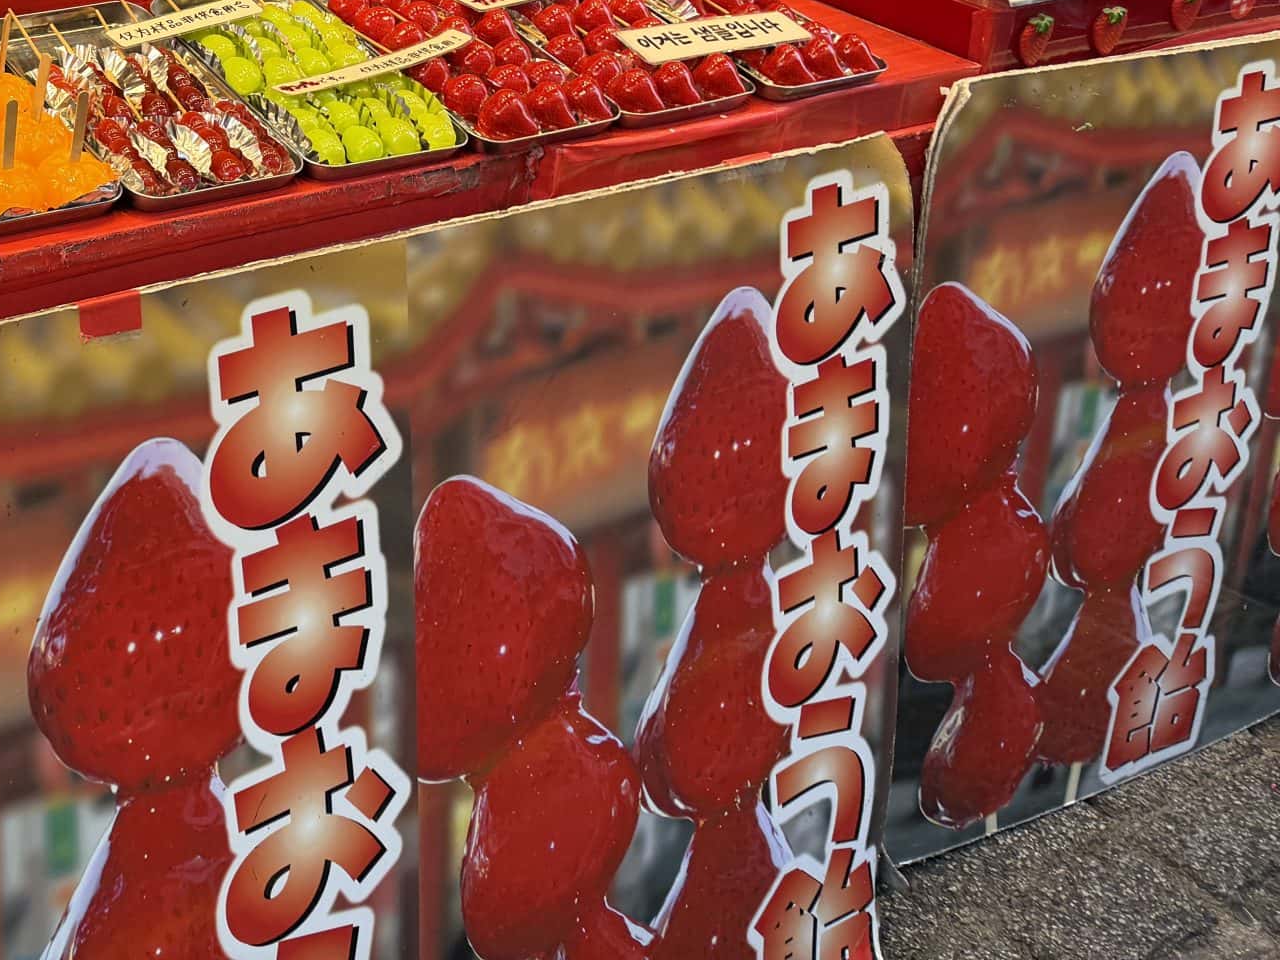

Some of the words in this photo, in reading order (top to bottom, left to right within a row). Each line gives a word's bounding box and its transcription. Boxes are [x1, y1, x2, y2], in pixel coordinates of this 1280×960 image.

[636, 31, 693, 50] 이거는
[690, 18, 784, 43] 샘플입니다
[206, 306, 397, 960] あまお
[750, 182, 896, 960] あまおう飴
